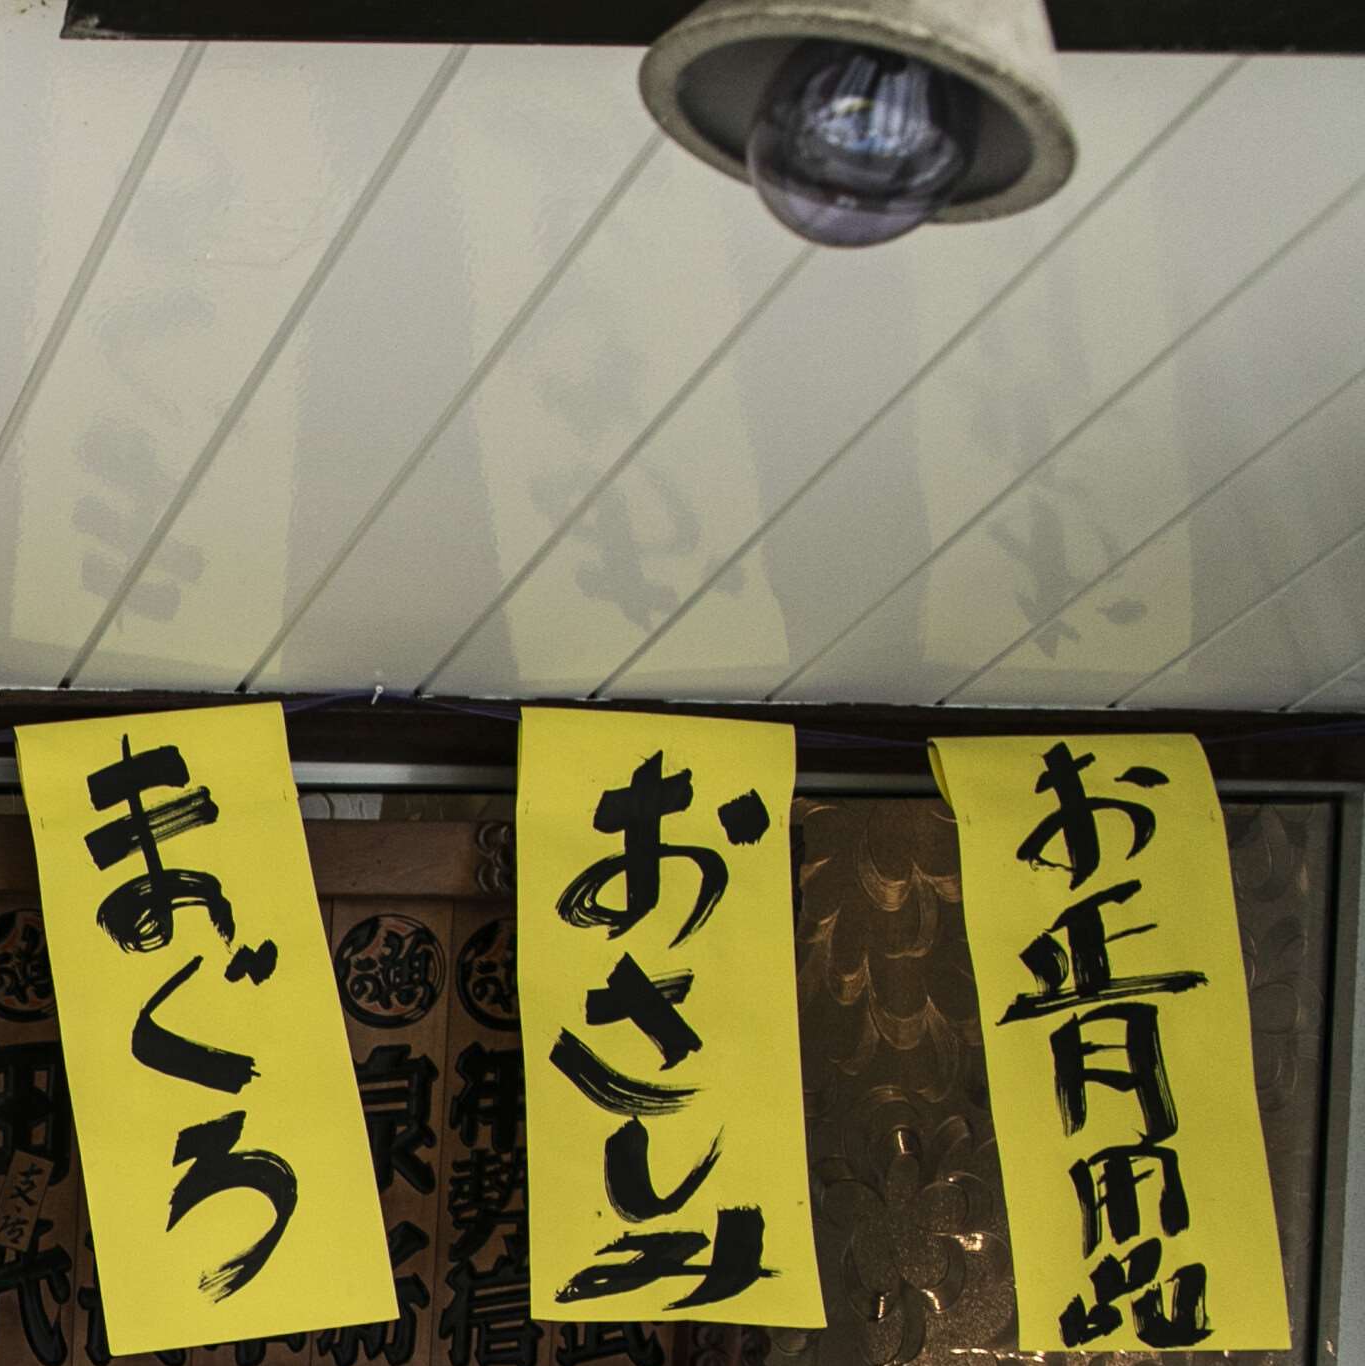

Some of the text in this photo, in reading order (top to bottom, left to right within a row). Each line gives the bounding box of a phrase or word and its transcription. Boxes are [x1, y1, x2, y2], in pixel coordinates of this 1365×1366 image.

[84, 732, 299, 1304] まぐろ
[549, 749, 782, 1311] おさしみ
[995, 741, 1211, 1348] お正月用品
